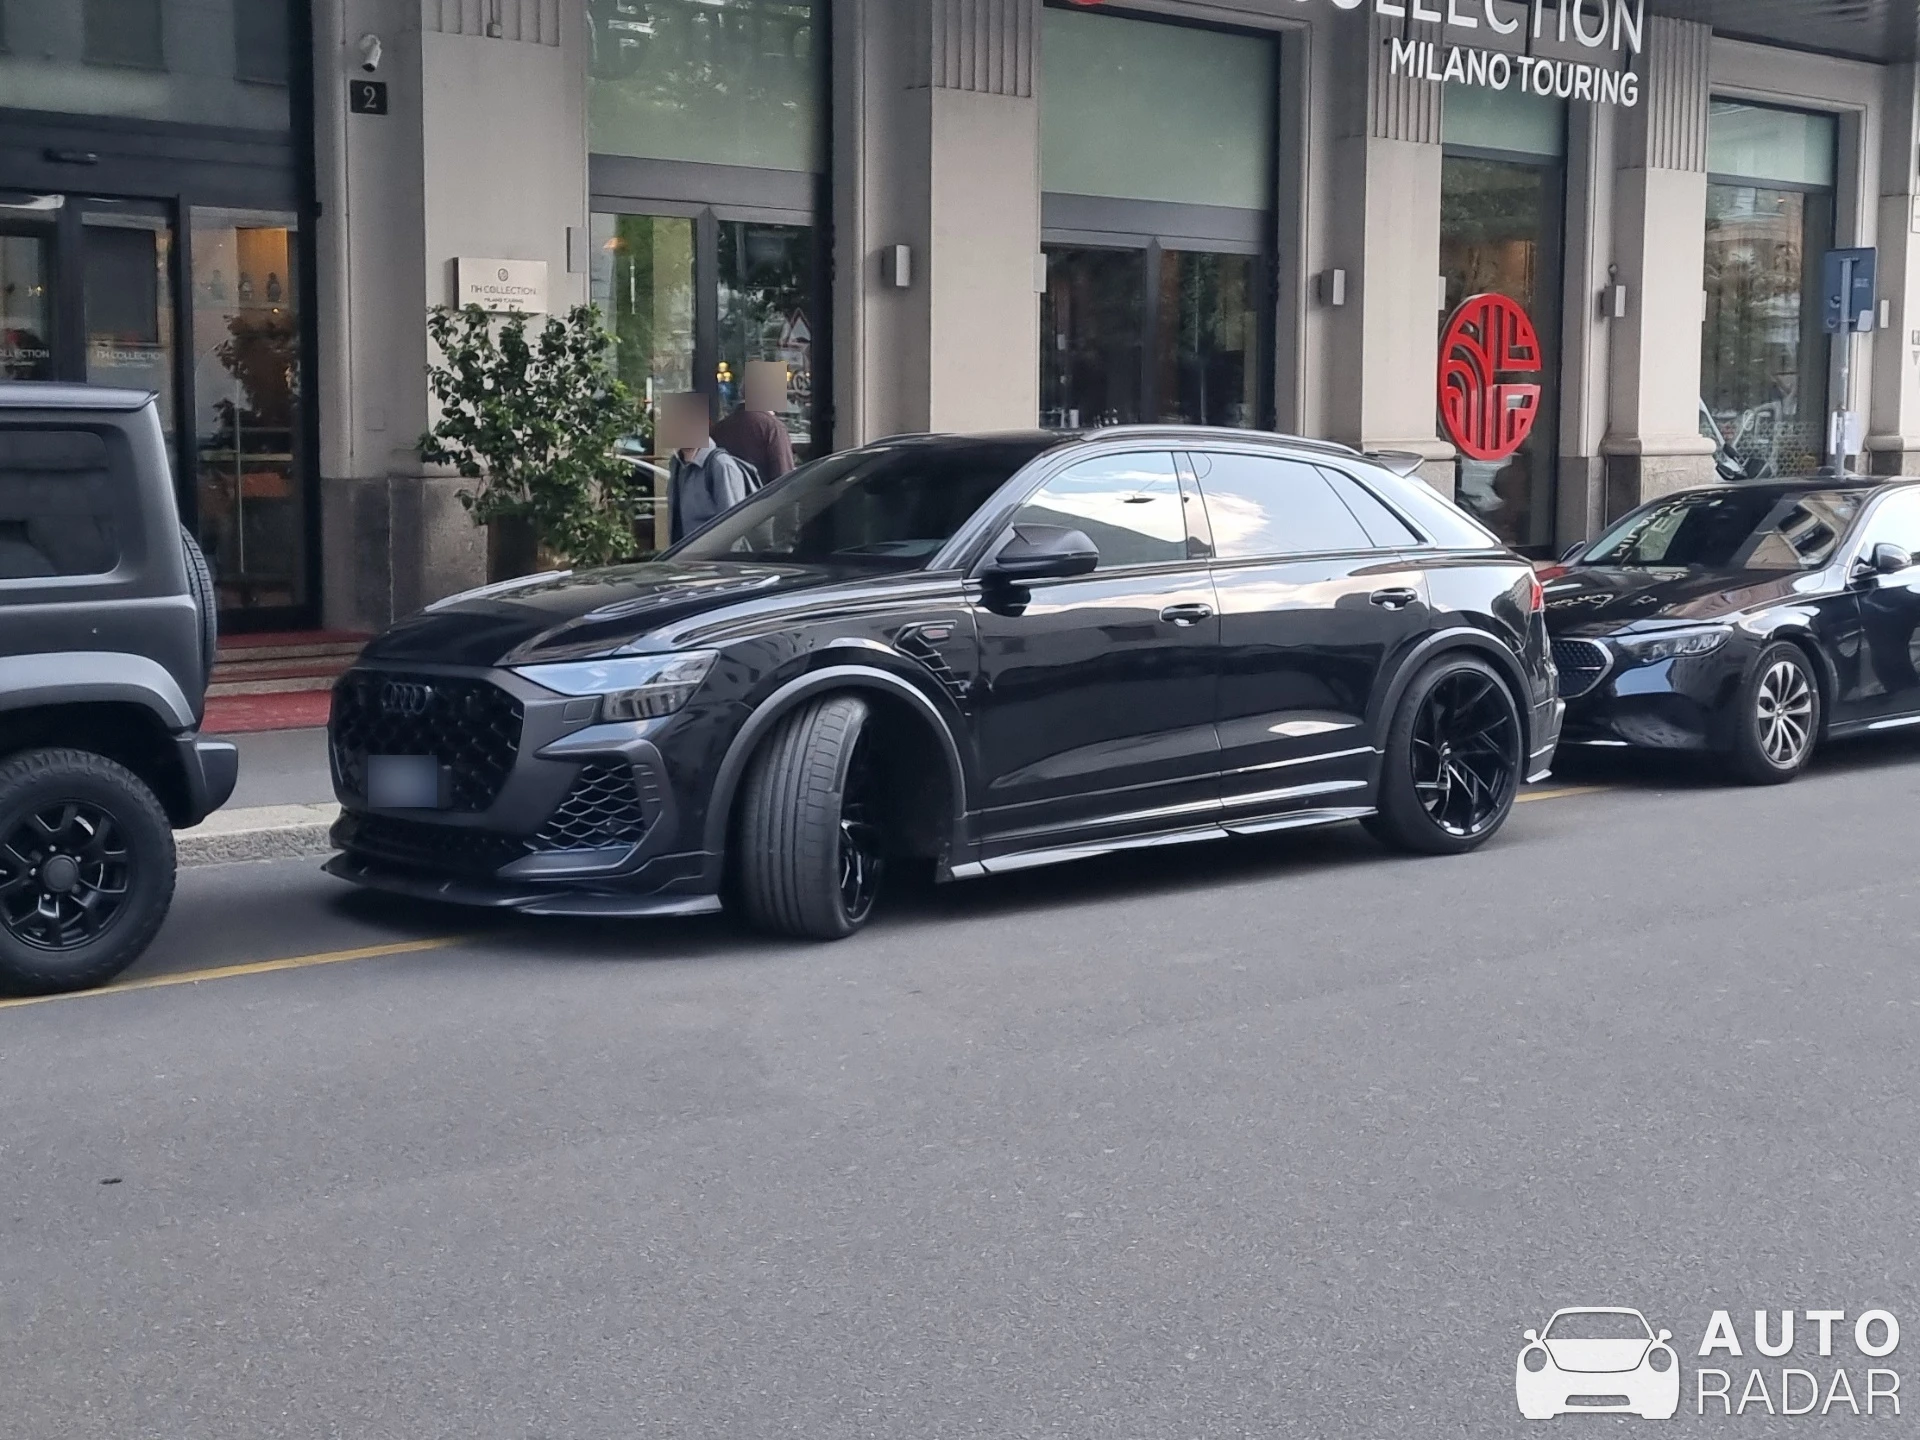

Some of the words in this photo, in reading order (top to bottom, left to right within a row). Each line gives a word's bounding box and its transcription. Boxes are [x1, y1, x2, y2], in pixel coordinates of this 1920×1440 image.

[1295, 0, 1642, 53] CTION
[1391, 37, 1511, 90] MILANO
[1517, 56, 1638, 107] TOURING
[363, 85, 377, 108] 2
[483, 285, 537, 295] COLLECTION
